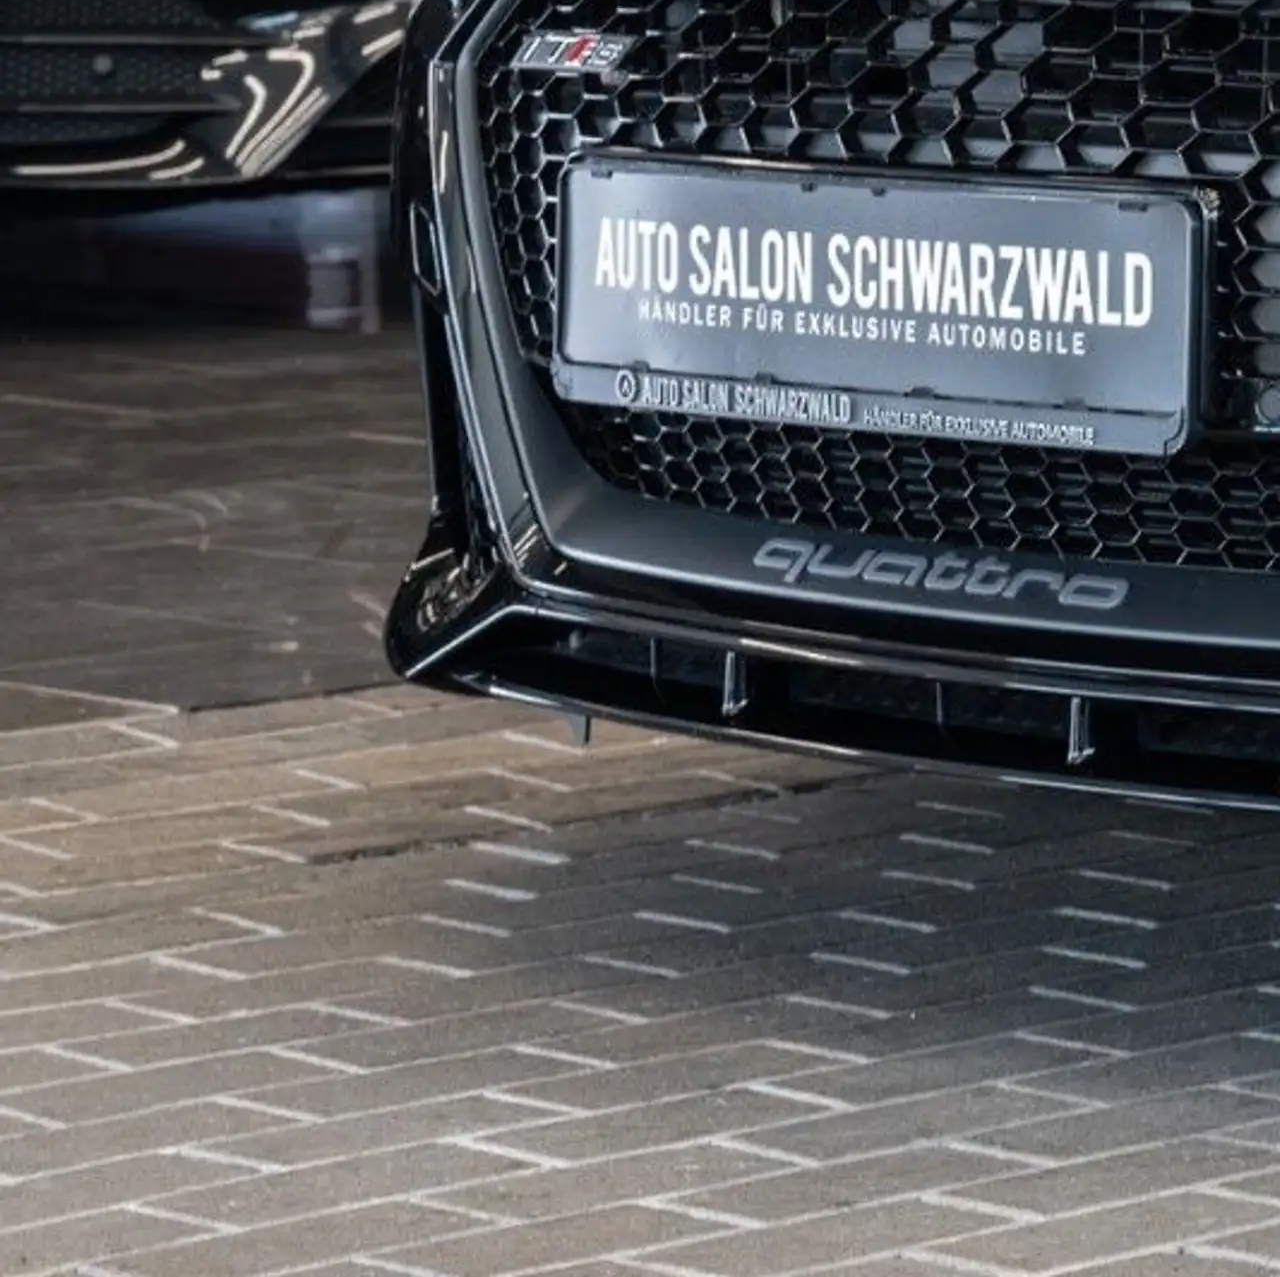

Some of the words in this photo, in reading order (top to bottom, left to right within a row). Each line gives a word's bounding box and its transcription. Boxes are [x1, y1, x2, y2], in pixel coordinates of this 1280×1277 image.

[595, 217, 679, 294] AUTO
[688, 224, 813, 304] SALON
[825, 232, 1153, 327] SCHWARZWALD
[637, 296, 732, 329] HÄNDLER
[742, 303, 783, 332] FÜR
[795, 311, 916, 343] EXKLUSIVE
[927, 324, 1087, 356] AUTOMOBILE
[641, 375, 679, 406] AUTO
[683, 377, 729, 412] SALON
[733, 385, 850, 423] SCHWARZWALD
[753, 538, 1130, 610] quattro
